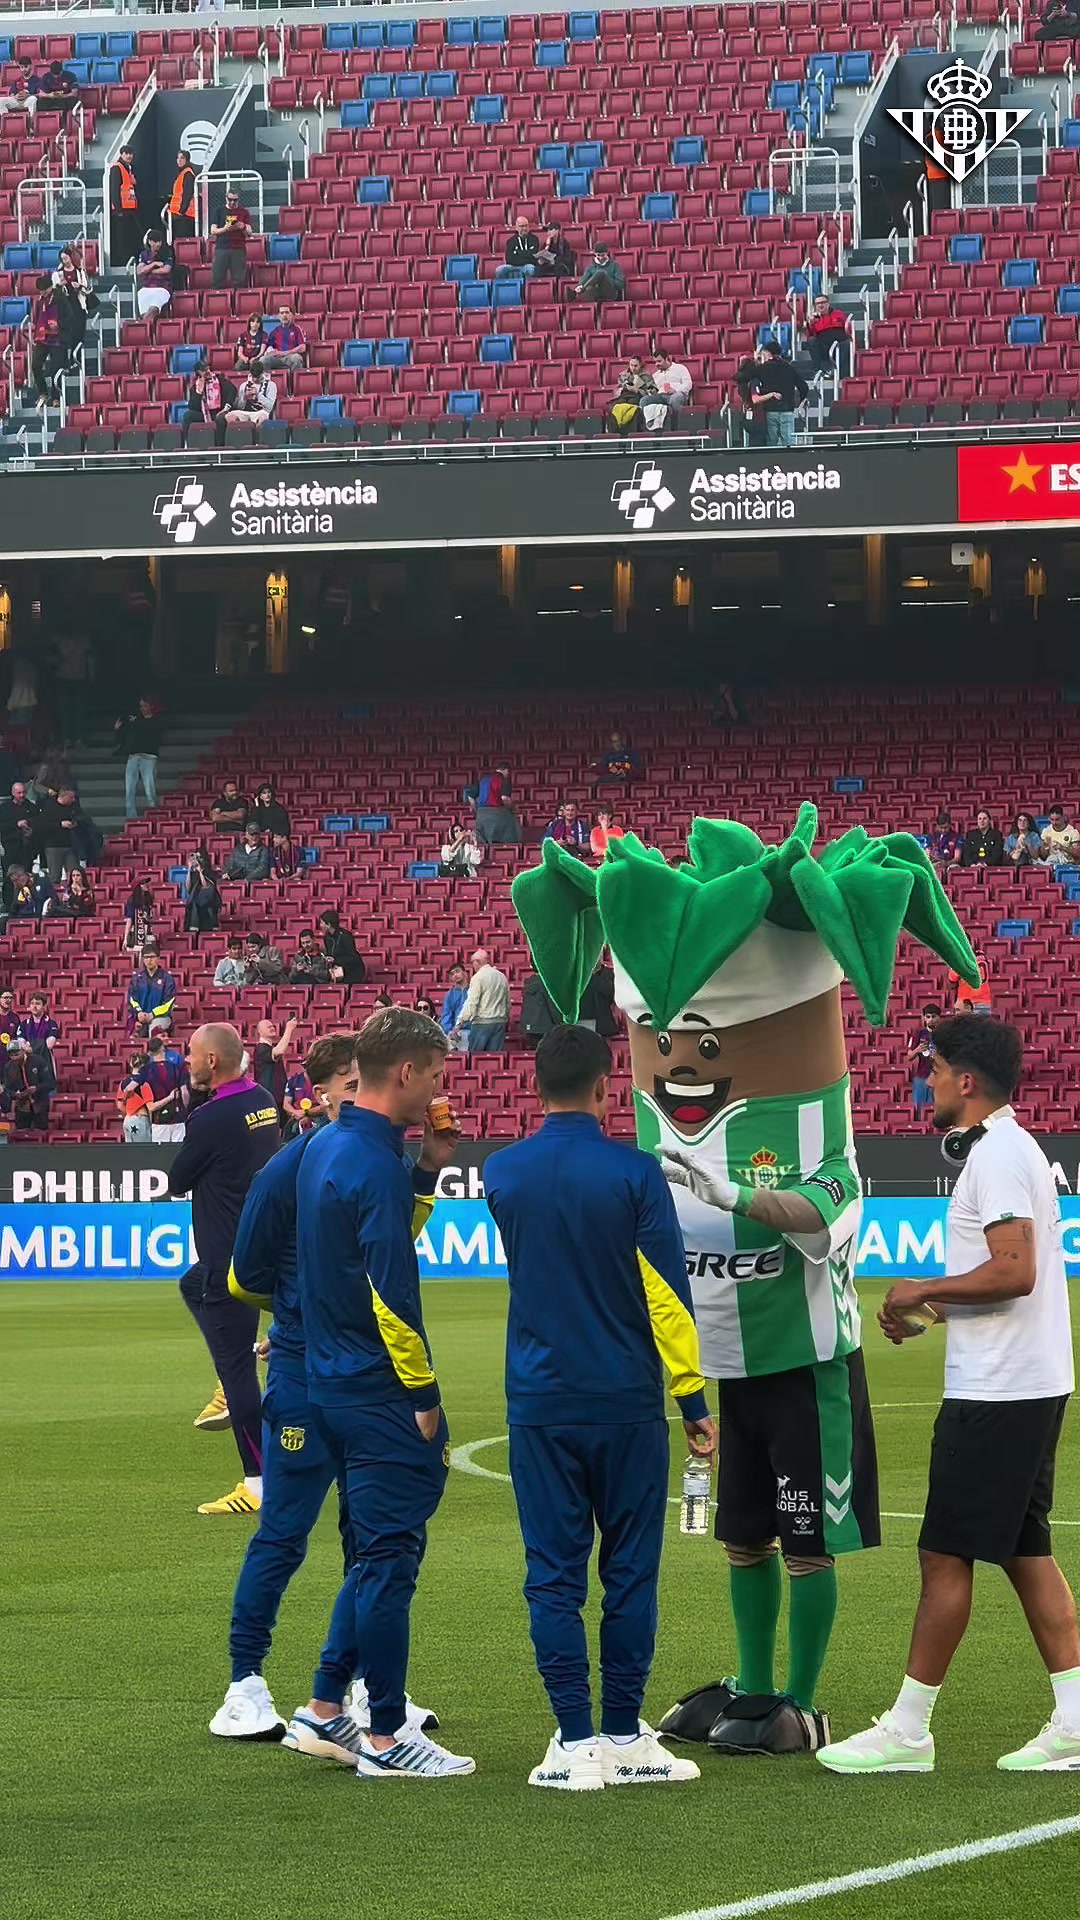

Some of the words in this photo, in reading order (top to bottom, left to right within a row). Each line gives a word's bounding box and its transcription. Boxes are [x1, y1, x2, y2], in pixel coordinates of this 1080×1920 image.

[690, 464, 840, 493] Assistència
[230, 479, 377, 508] Assistència
[690, 493, 795, 522] Sanitària
[231, 508, 333, 536] Sanitària
[13, 1169, 187, 1203] PHILIP
[780, 1490, 809, 1501] AUS
